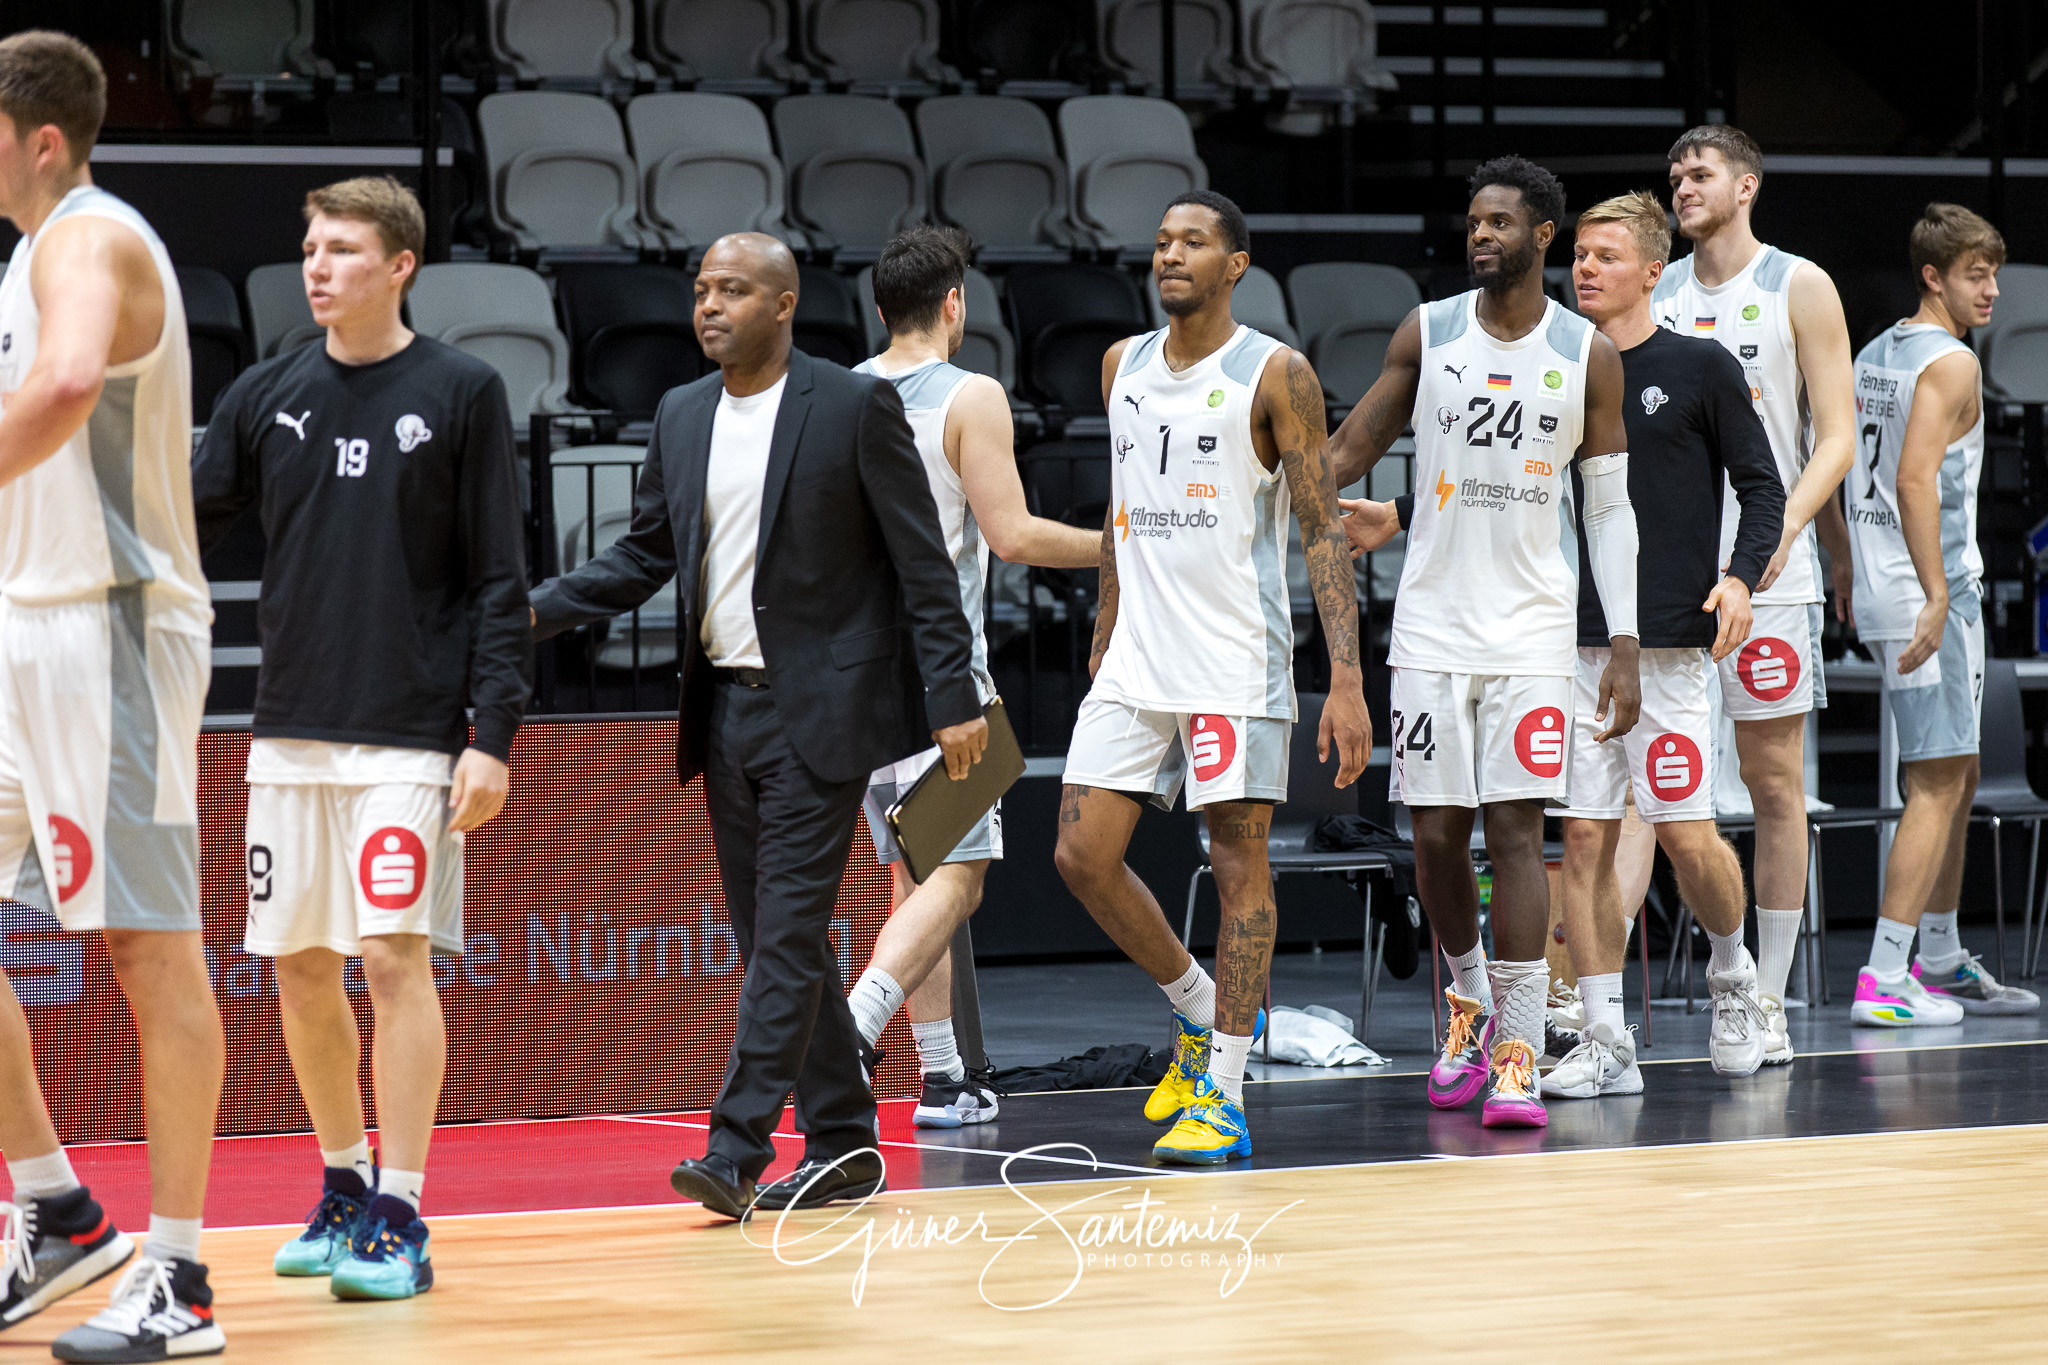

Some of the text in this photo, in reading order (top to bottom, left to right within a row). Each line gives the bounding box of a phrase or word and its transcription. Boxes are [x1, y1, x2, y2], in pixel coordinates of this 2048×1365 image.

[1466, 396, 1523, 450] 24
[334, 437, 370, 478] 19
[1159, 425, 1171, 475] 1
[1525, 459, 1553, 477] EMS
[1863, 423, 1882, 499] 7
[1186, 483, 1217, 499] EMS
[1460, 497, 1506, 512] nürnberg
[1461, 478, 1549, 506] filmstudio
[1131, 507, 1218, 529] filmstudio
[1392, 709, 1436, 761] 24
[526, 902, 850, 985] Nürnb
